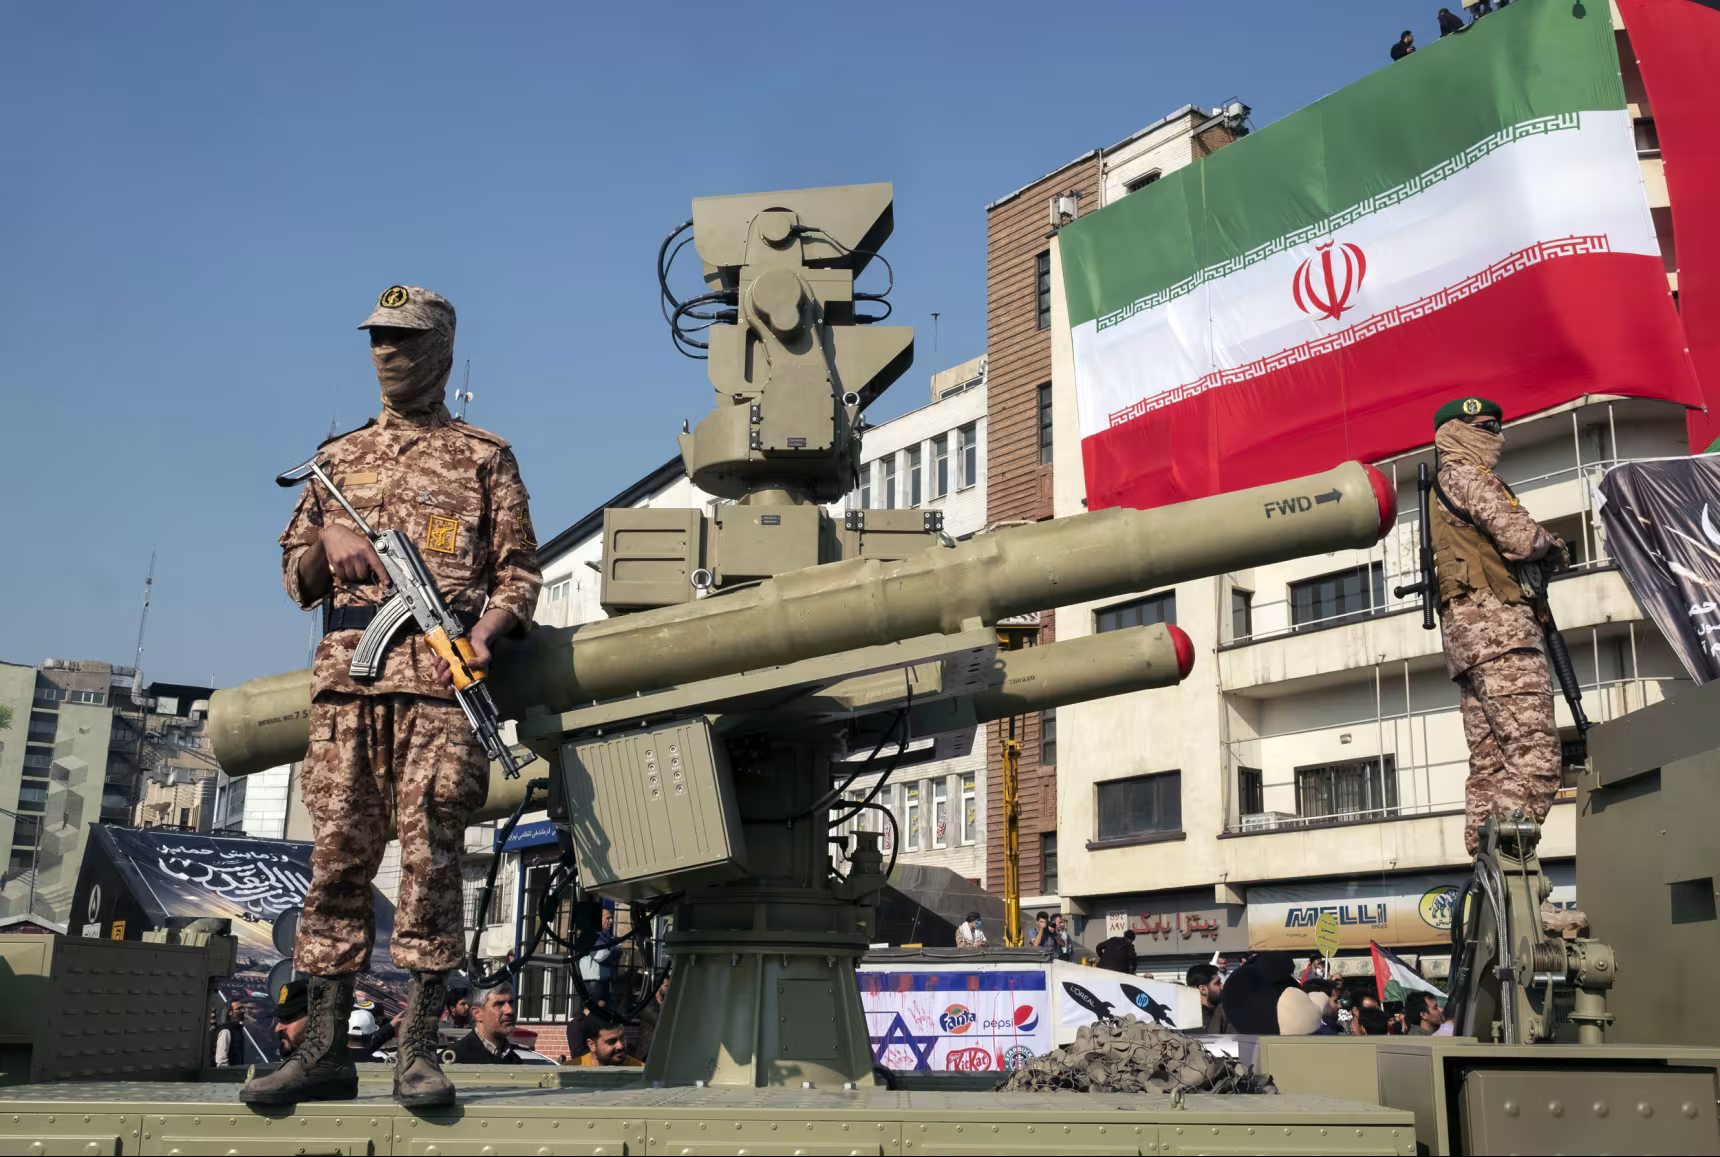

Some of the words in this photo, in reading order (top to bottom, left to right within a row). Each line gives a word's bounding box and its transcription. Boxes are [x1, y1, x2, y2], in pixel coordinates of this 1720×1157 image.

[1264, 496, 1312, 519] FWD
[1132, 911, 1171, 941] بابک
[1176, 911, 1218, 941] پیتزا
[1137, 994, 1148, 1007] hp
[939, 1009, 976, 1032] Fanta
[983, 1017, 1014, 1030] pepsi
[1005, 1047, 1035, 1061] STARBUCK
